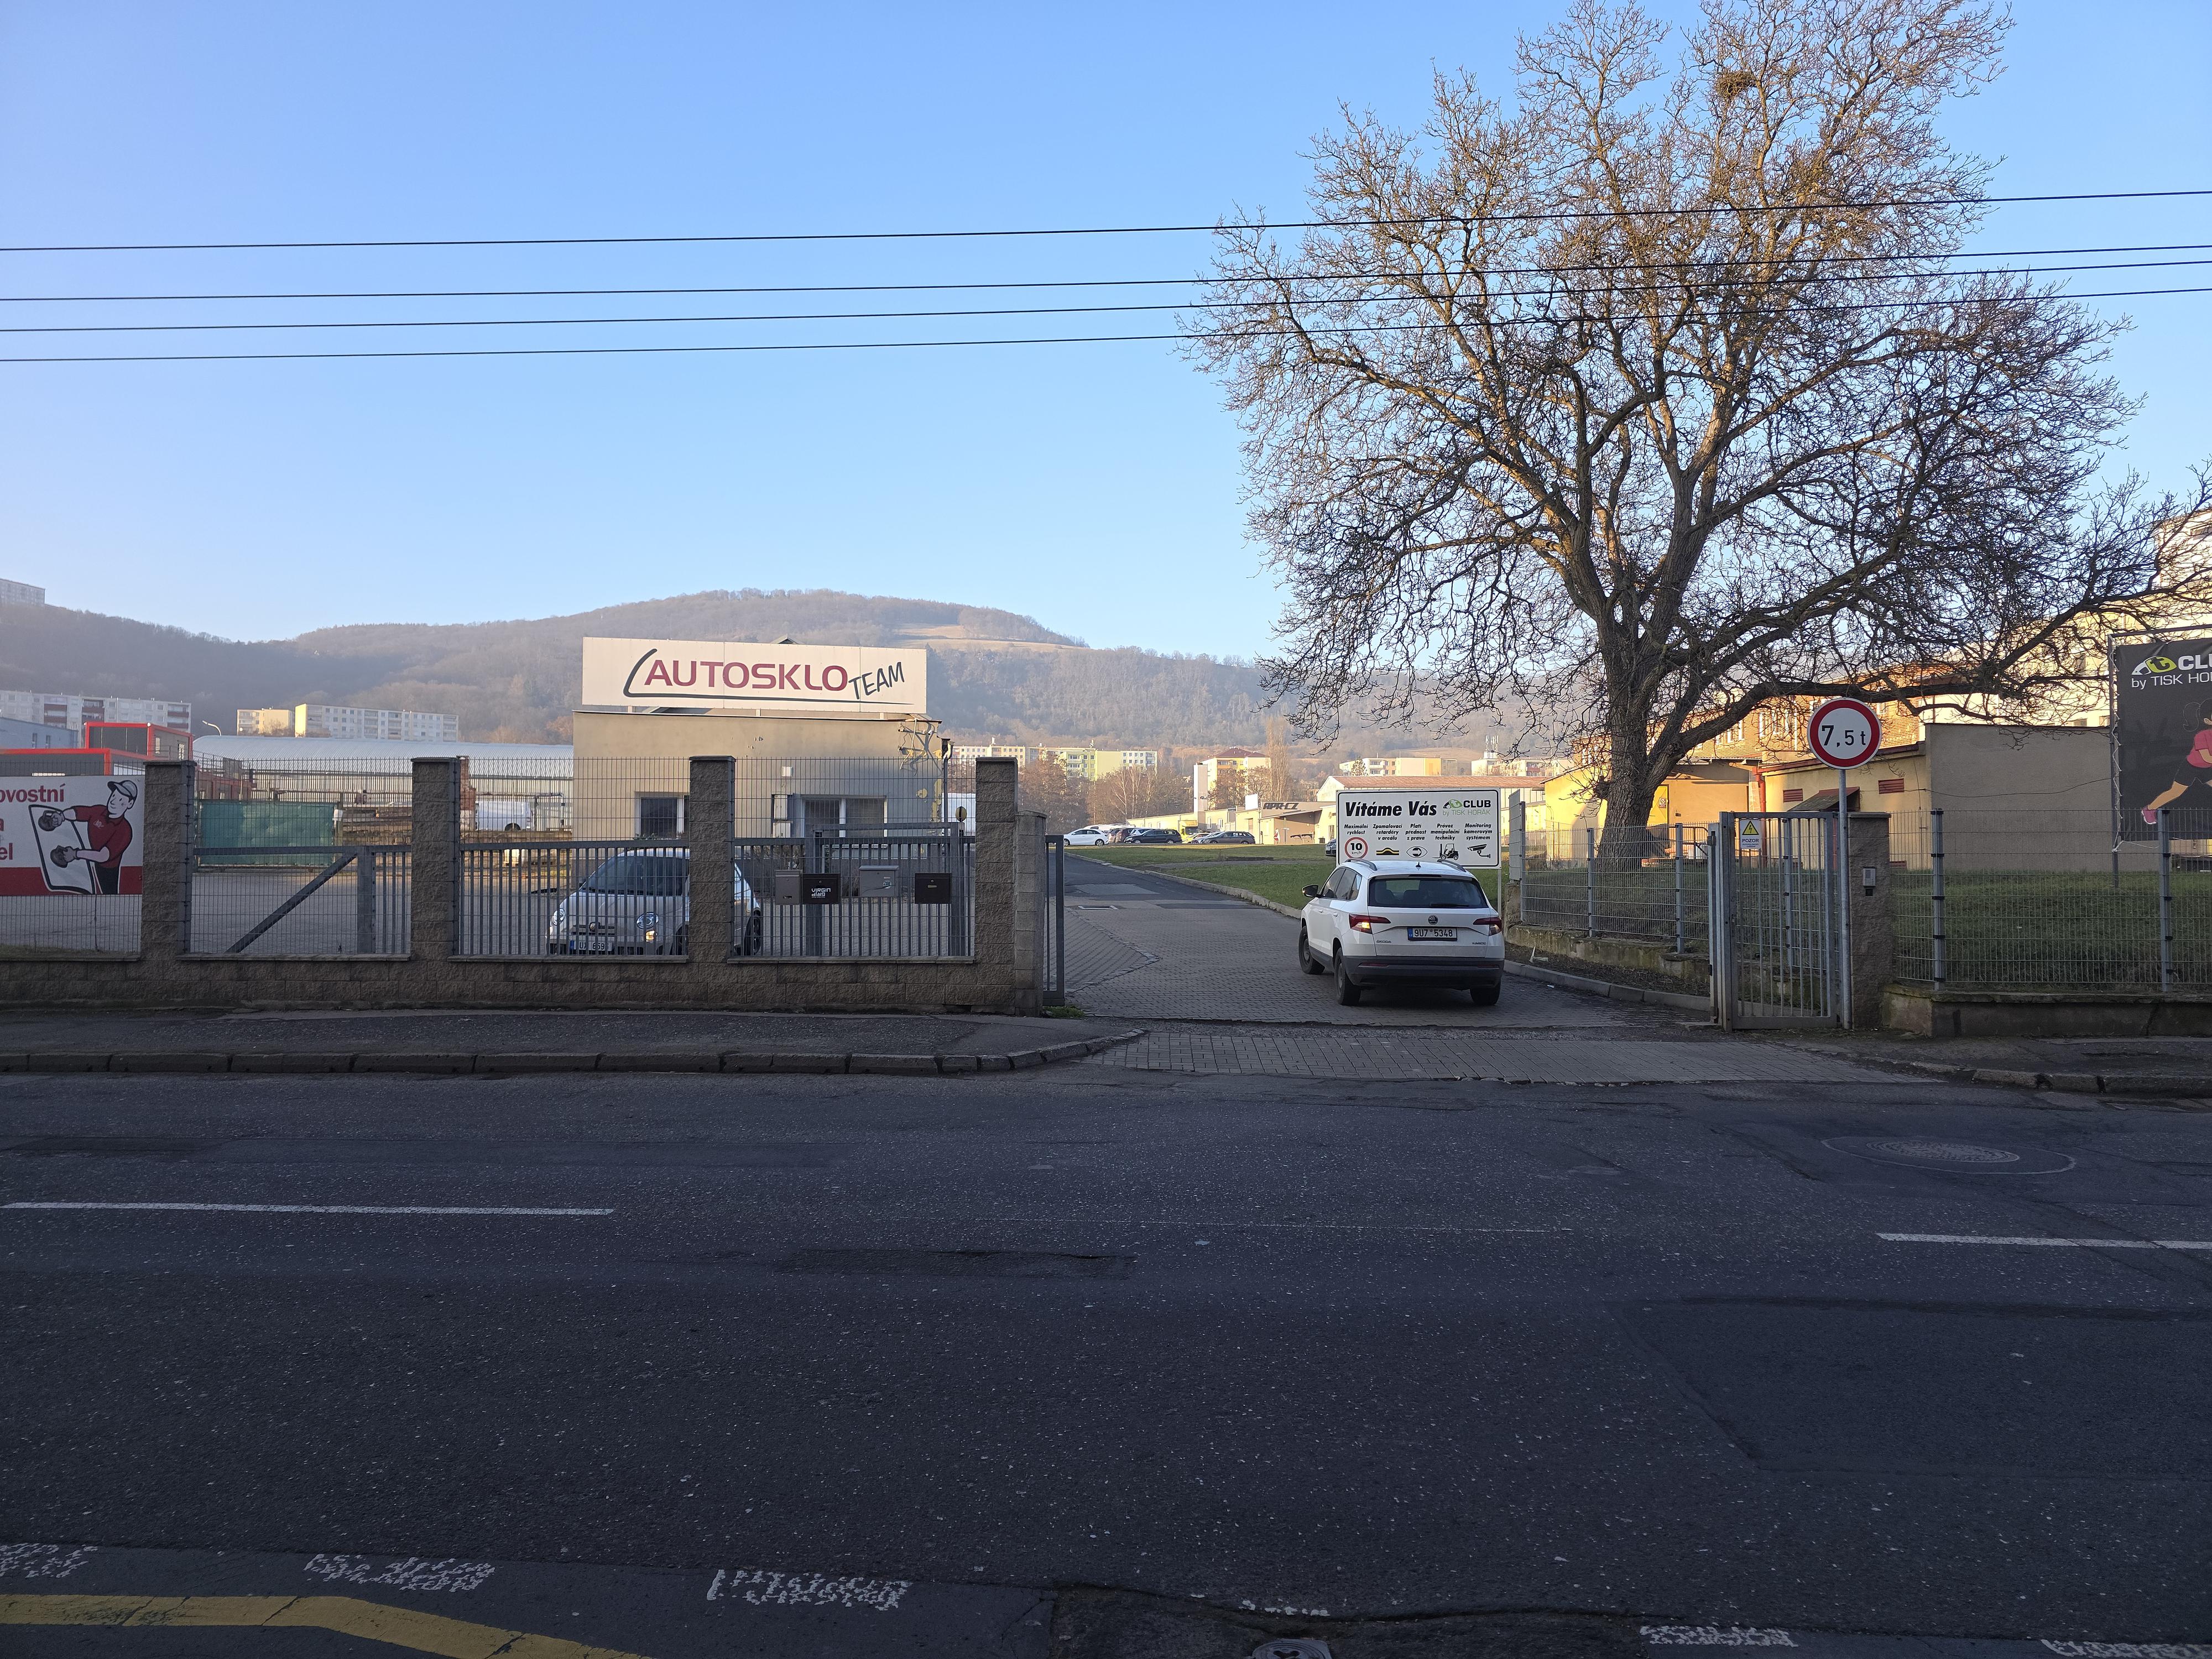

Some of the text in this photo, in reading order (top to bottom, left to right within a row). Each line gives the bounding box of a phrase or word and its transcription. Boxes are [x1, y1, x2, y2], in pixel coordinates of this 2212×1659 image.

[644, 660, 848, 691] AUTOSKLO
[849, 662, 905, 699] TEAM
[2131, 671, 2212, 690] by TISK HO
[1345, 801, 1437, 816] Vítáme Vás
